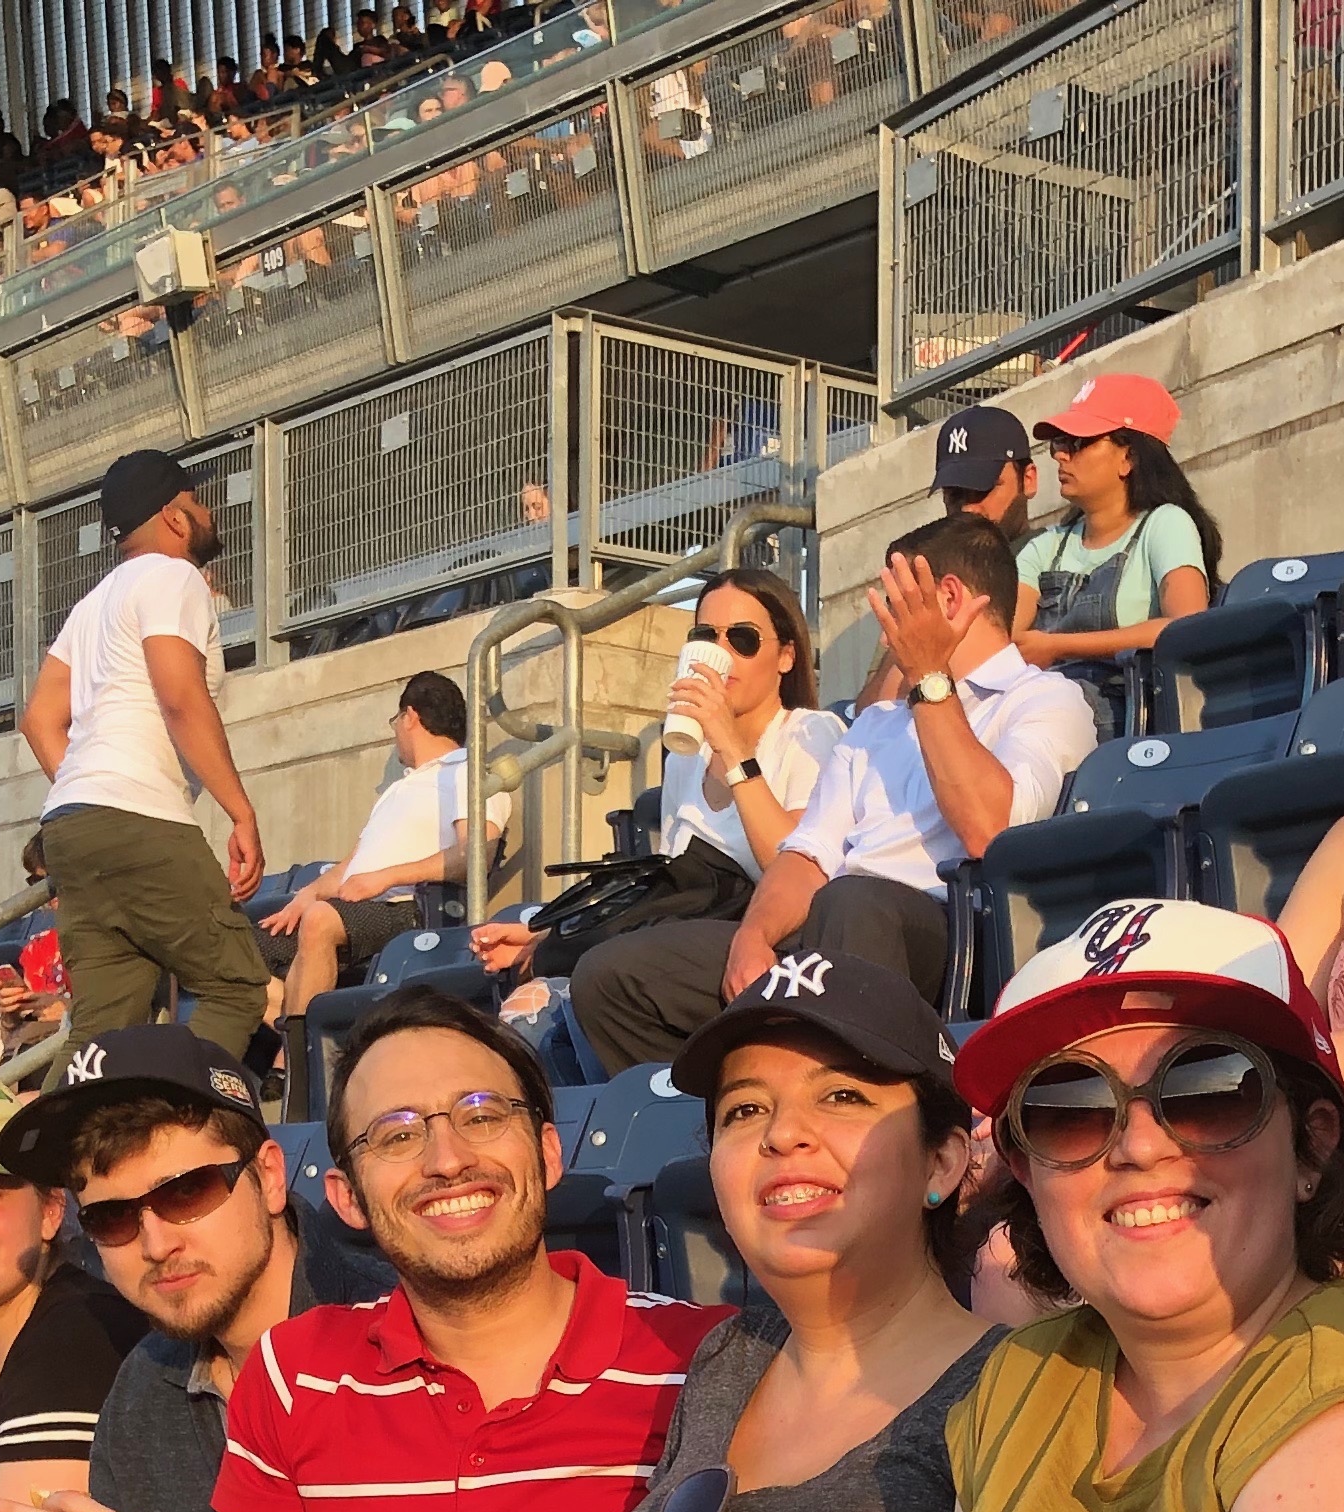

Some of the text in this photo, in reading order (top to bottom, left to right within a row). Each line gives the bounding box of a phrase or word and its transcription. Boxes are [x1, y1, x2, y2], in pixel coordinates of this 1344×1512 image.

[263, 246, 284, 272] 409
[948, 427, 968, 454] NY
[1143, 747, 1155, 759] 6
[760, 952, 834, 1001] NY
[66, 1041, 108, 1086] NY
